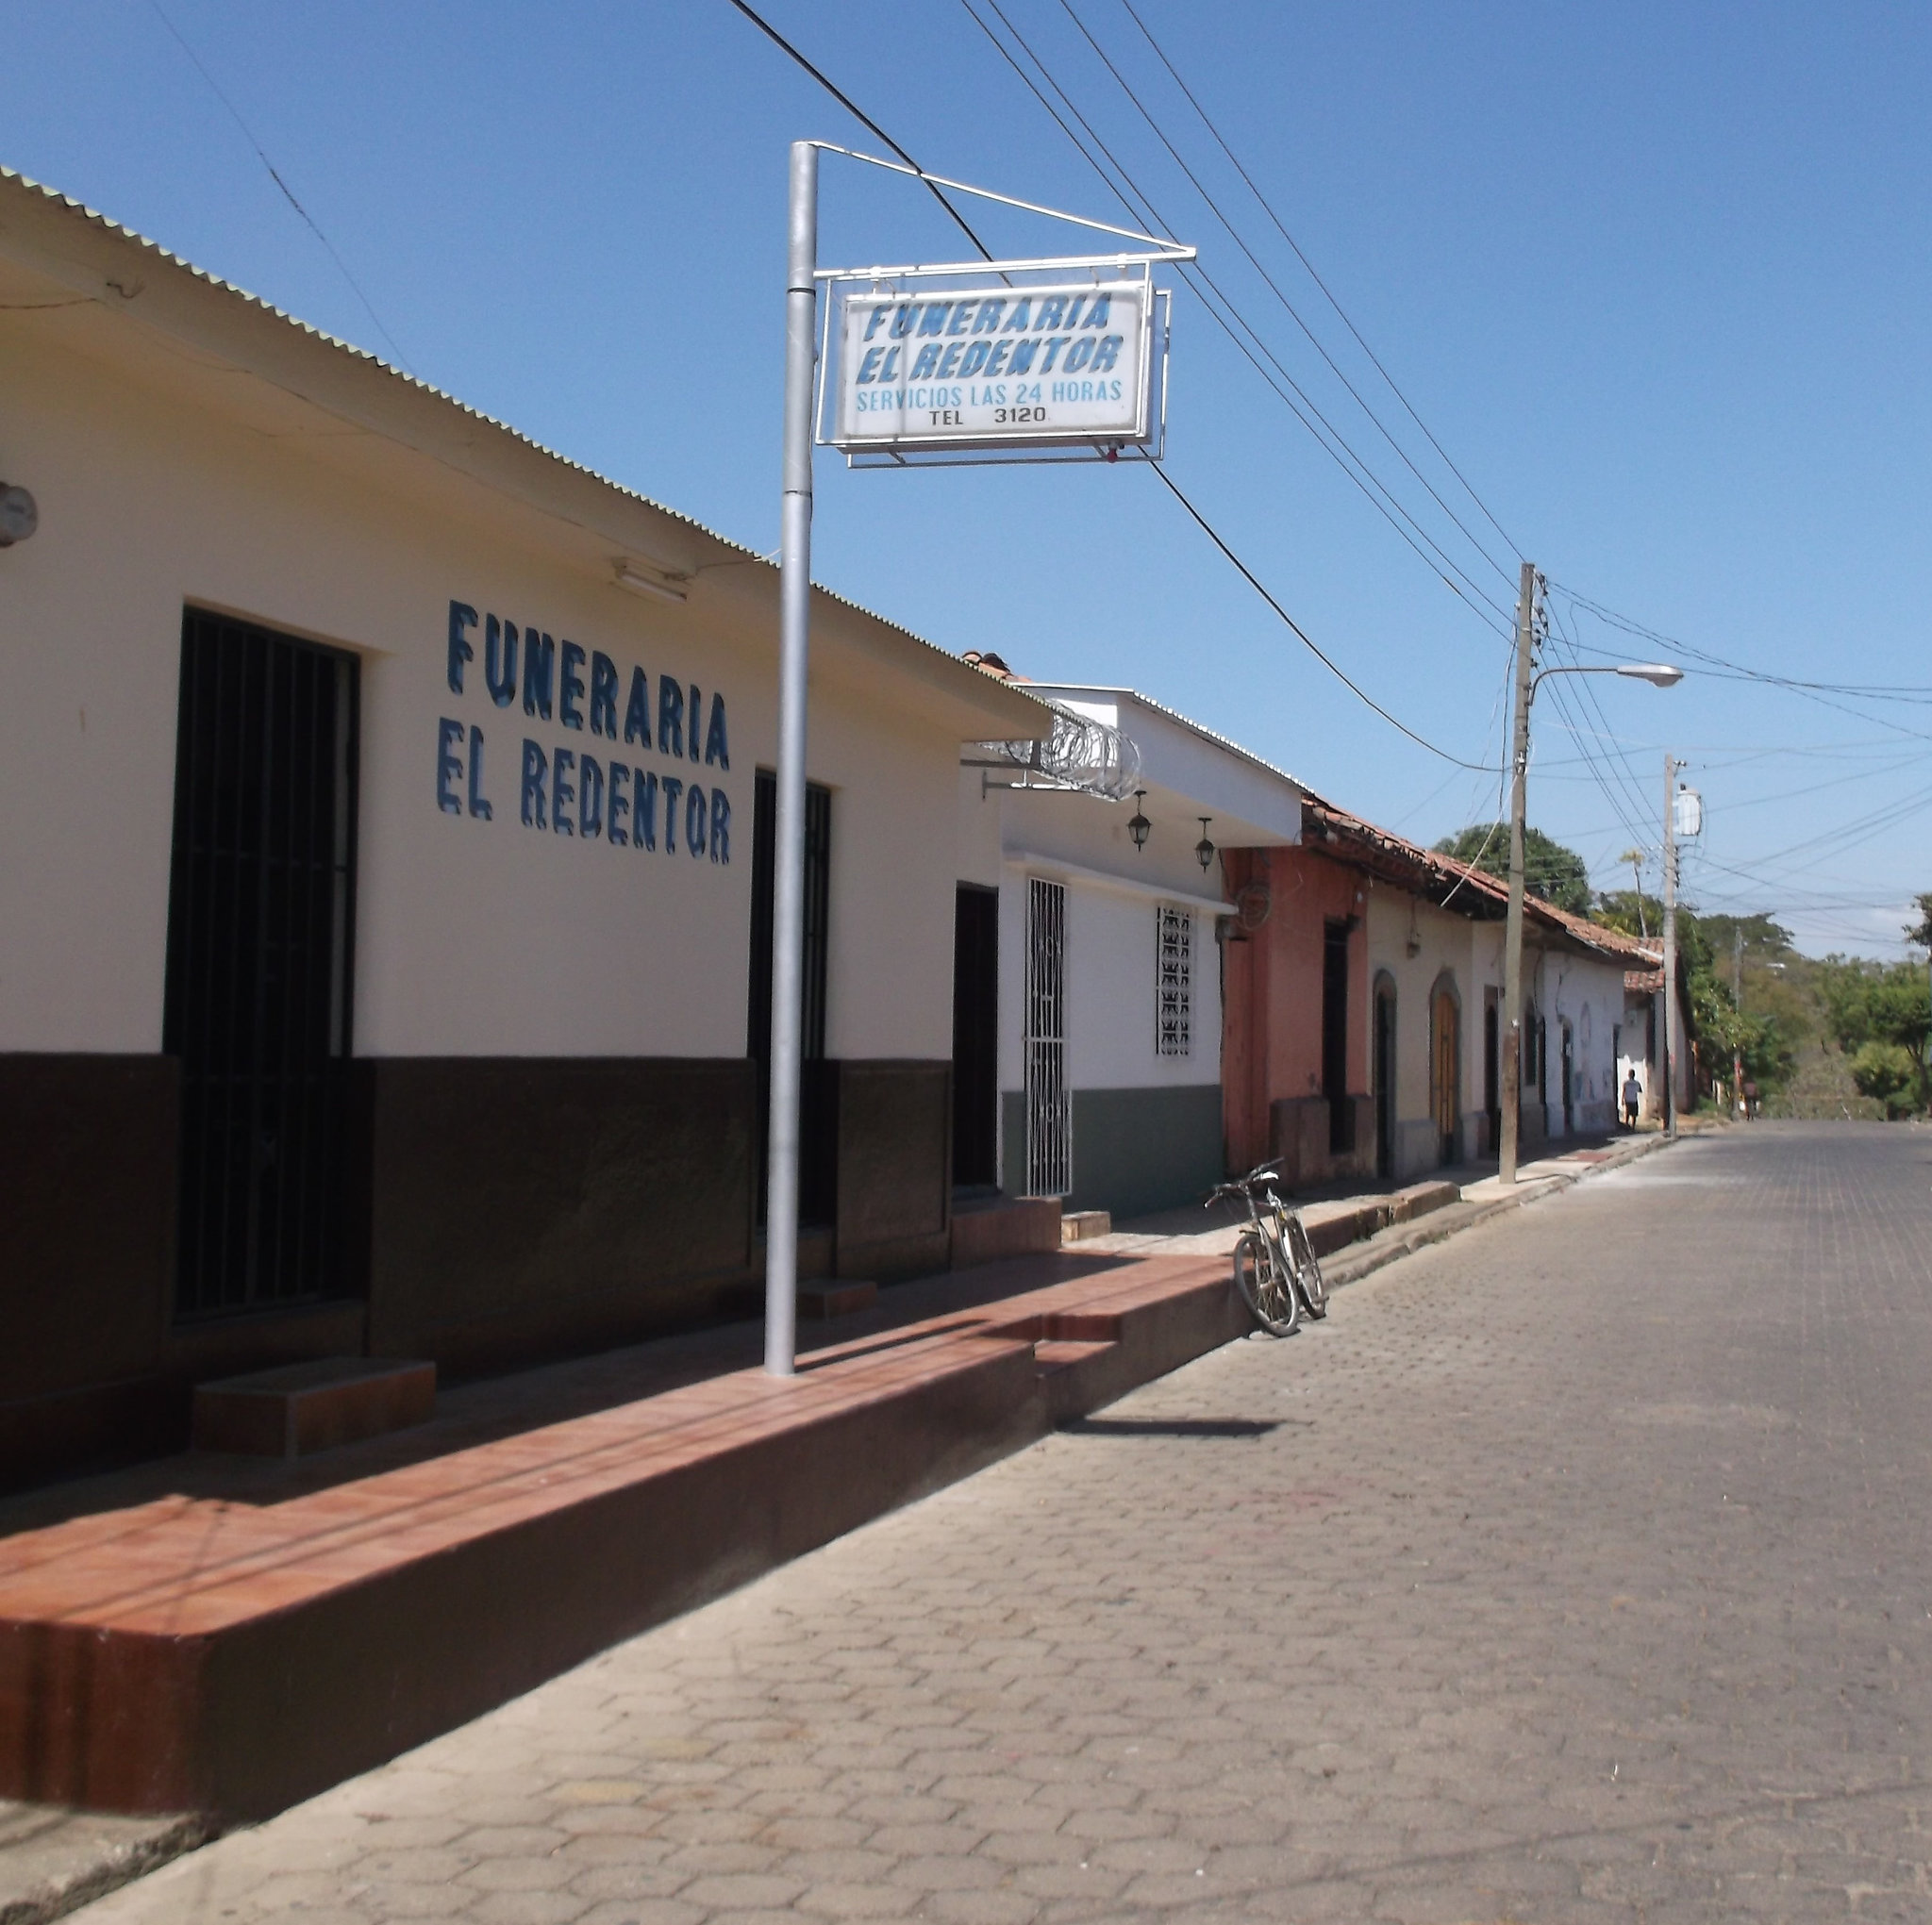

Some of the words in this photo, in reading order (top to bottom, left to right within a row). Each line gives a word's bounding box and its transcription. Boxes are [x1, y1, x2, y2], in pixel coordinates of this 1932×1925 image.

[862, 292, 1112, 342] FUNERARIA
[856, 346, 901, 385] EL
[908, 335, 1124, 382] REDENTOR
[857, 387, 963, 412] SERVICIOS
[971, 385, 1007, 406] LAS
[1015, 383, 1041, 404] 24
[1052, 380, 1123, 403] HORAS
[929, 410, 963, 425] TEL
[994, 407, 1046, 423] 3120
[447, 599, 730, 772] FUNERARIA
[437, 717, 492, 821] EL
[521, 738, 731, 866] REDENTOR
